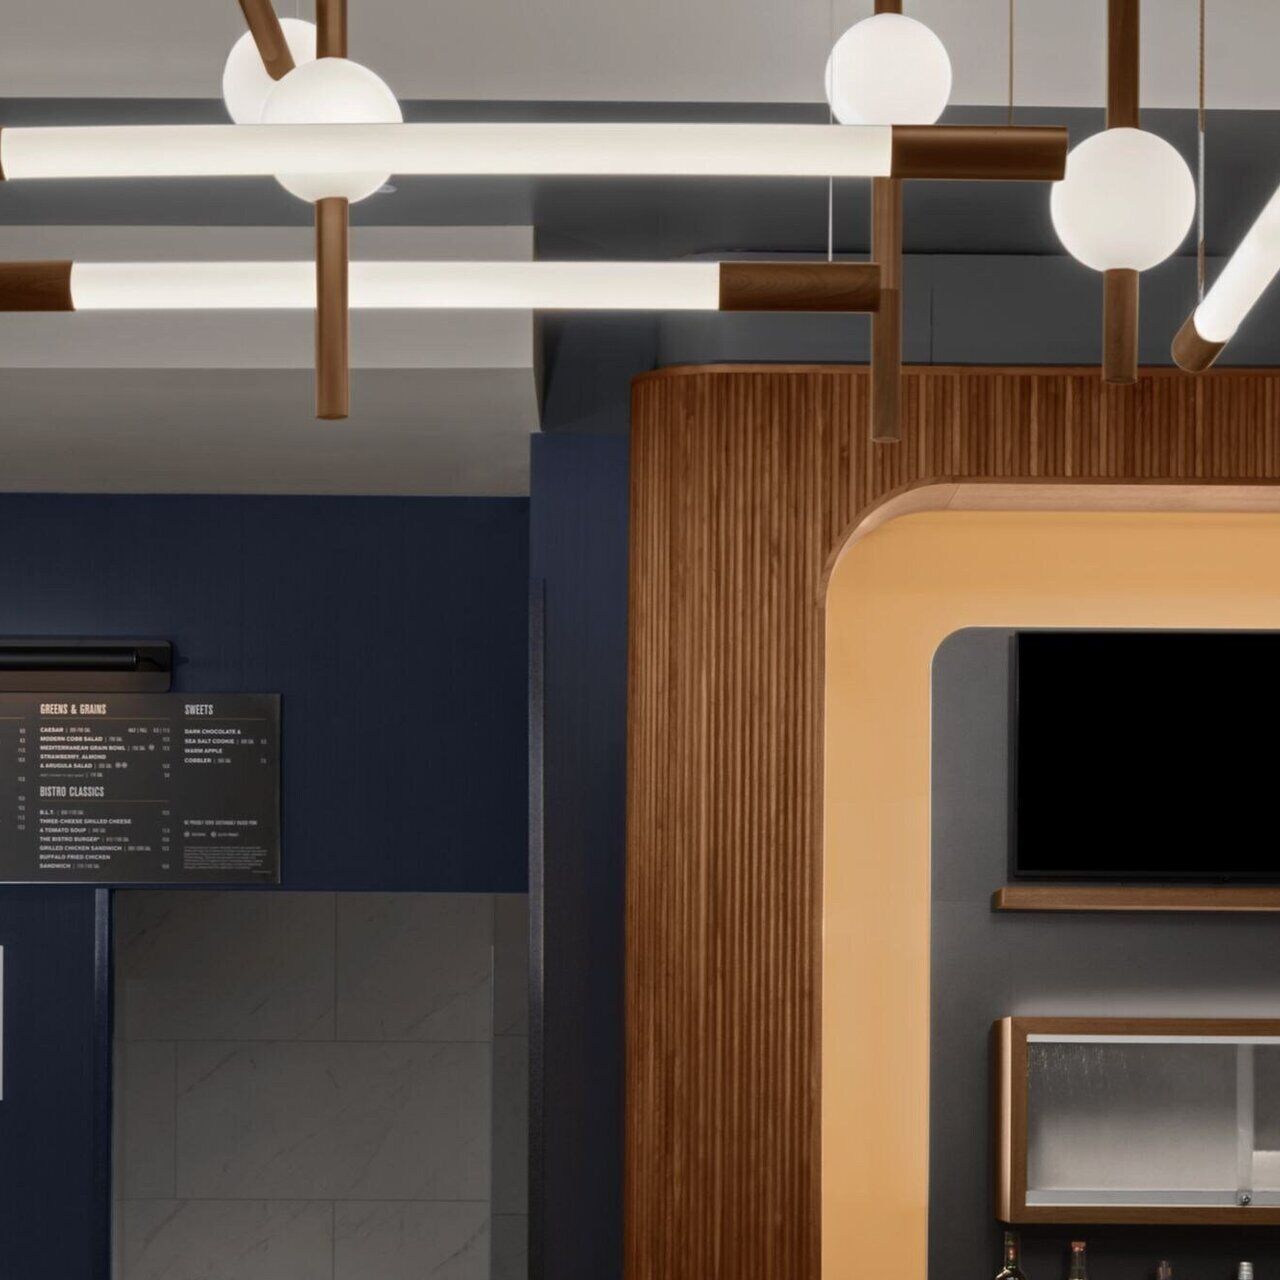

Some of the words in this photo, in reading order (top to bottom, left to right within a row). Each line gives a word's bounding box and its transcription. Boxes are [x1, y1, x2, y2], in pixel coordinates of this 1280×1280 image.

[40, 704, 68, 715] GREENS
[70, 704, 77, 715] &
[80, 704, 106, 715] GRAINS
[184, 704, 214, 715] SWEETS
[40, 786, 66, 797] BISTRO
[69, 786, 105, 797] CLASSICS
